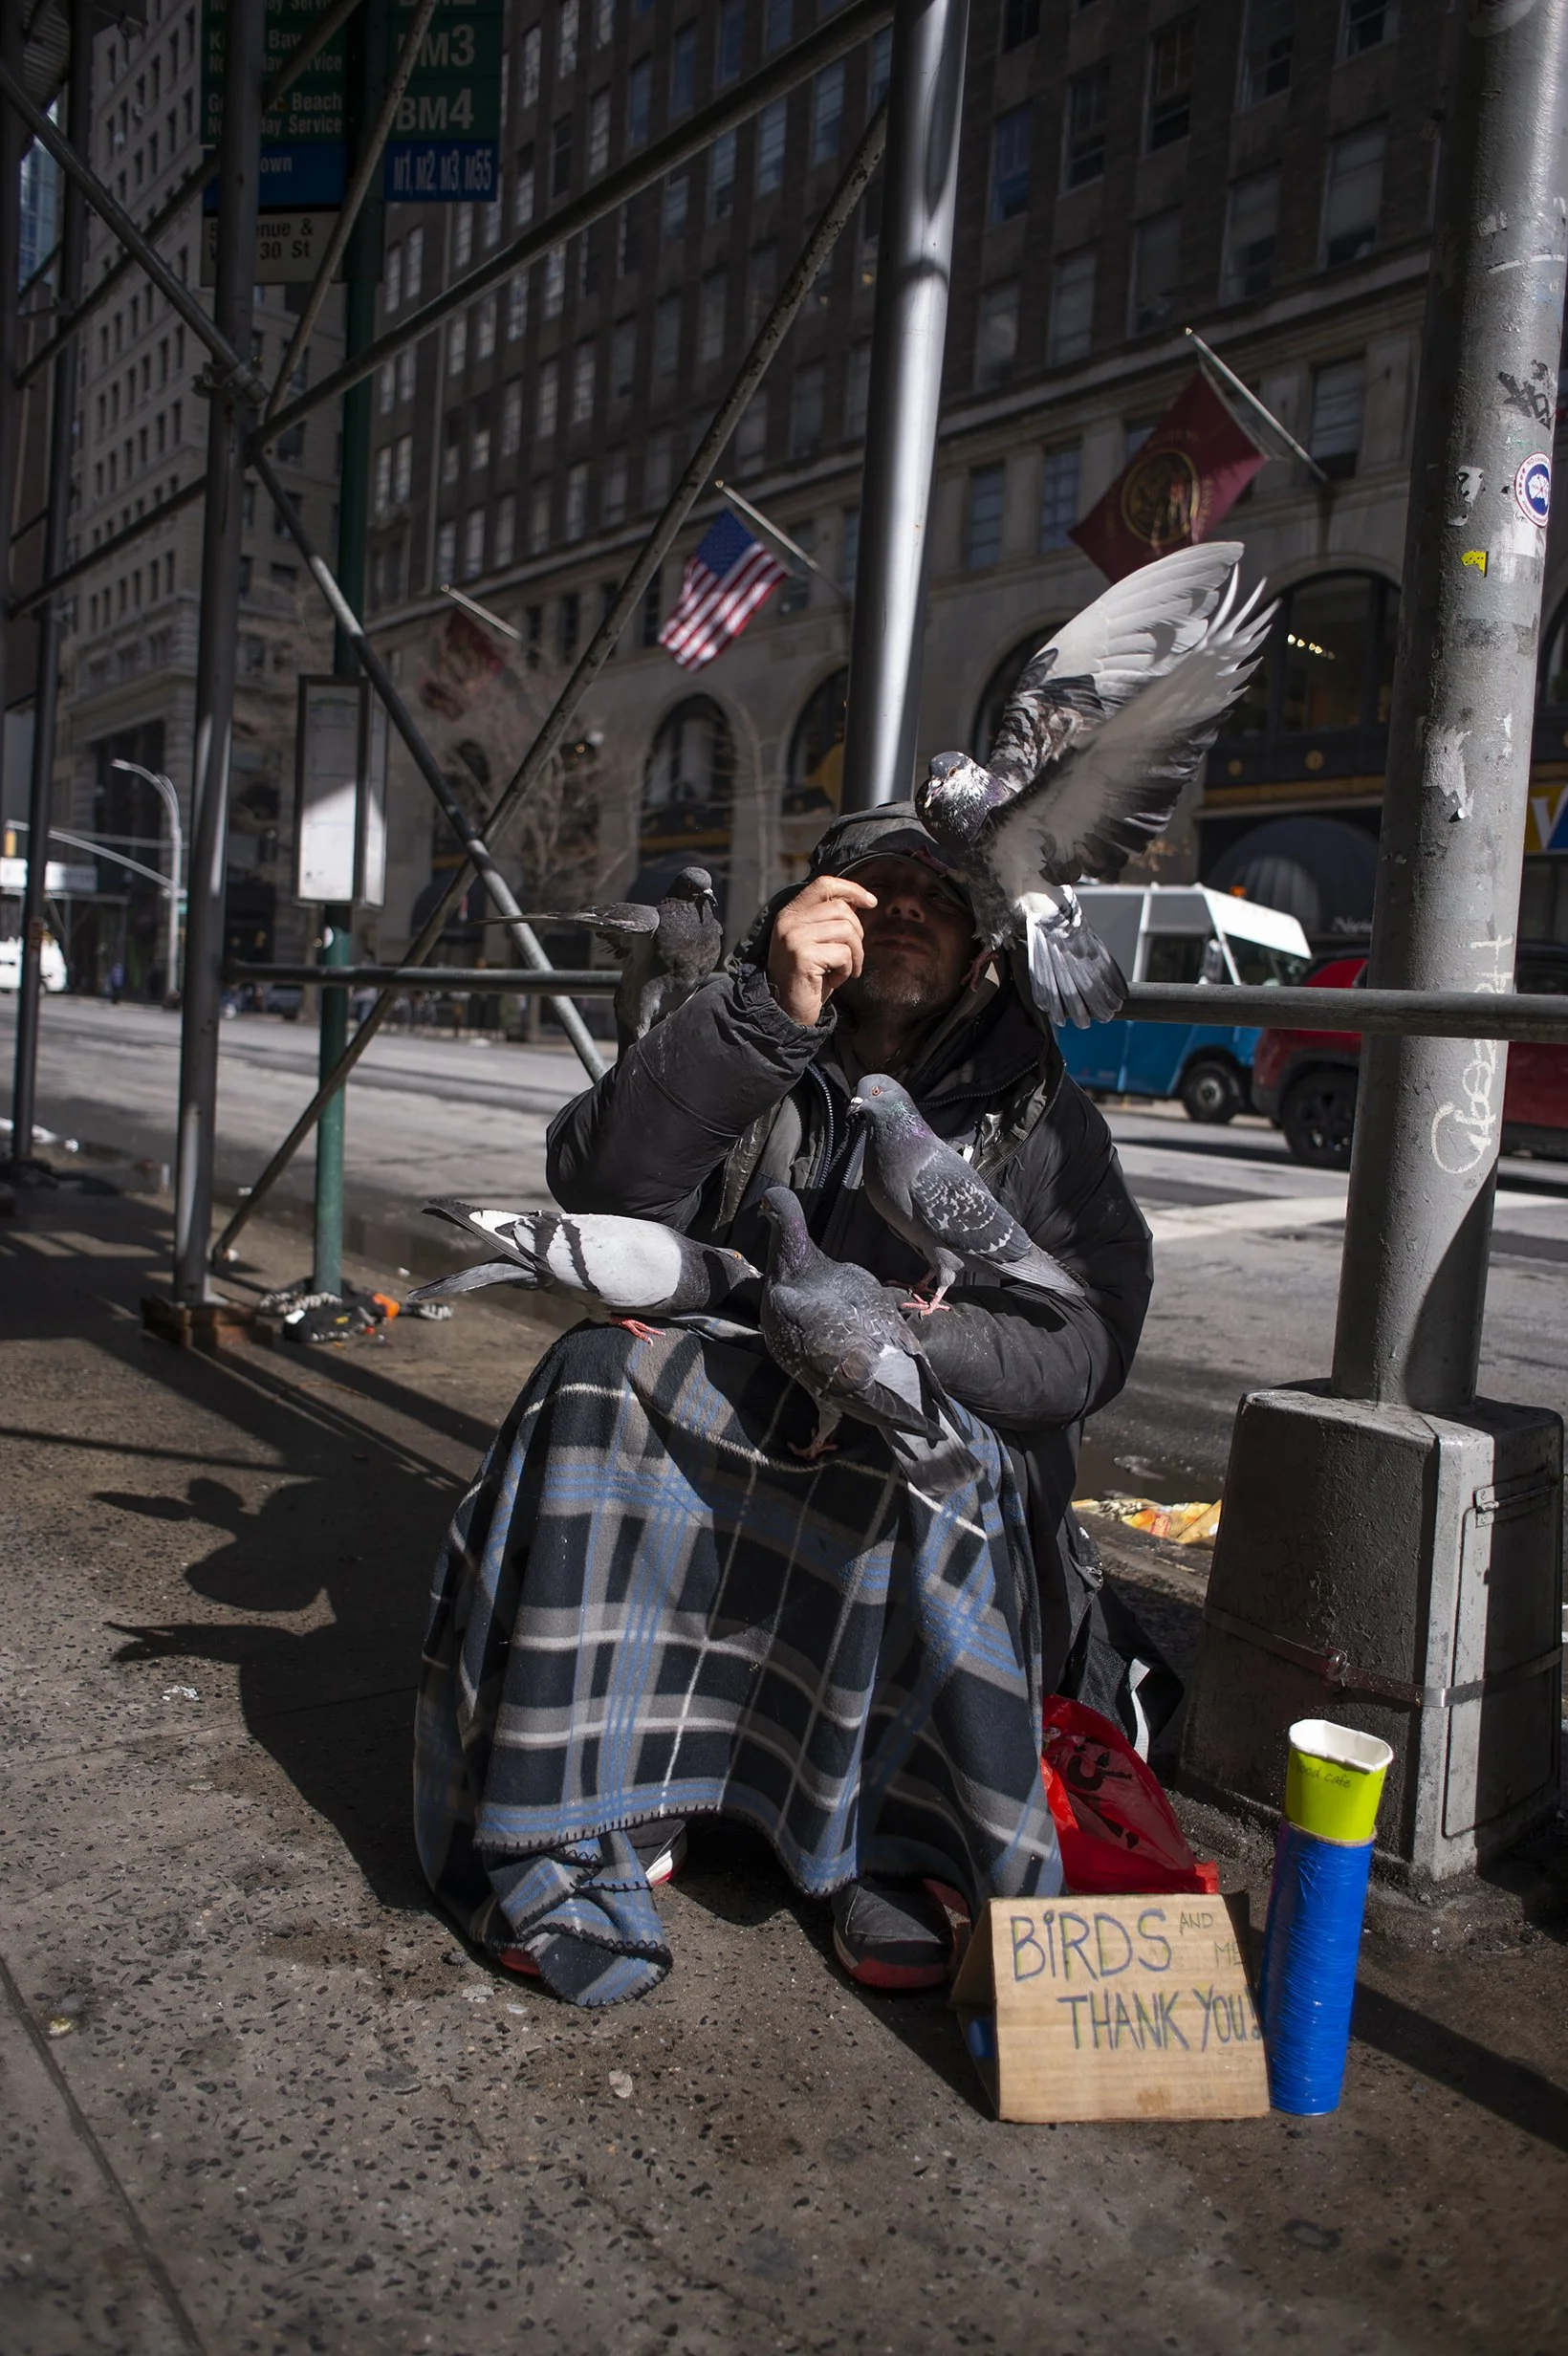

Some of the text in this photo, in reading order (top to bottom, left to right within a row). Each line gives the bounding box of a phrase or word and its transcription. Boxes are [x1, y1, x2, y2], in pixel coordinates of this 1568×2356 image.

[292, 93, 342, 112] Beach
[395, 88, 474, 132] BM4
[288, 114, 342, 136] Service
[464, 148, 492, 192] M55
[300, 218, 314, 236] &
[259, 240, 311, 261] 30 St
[1179, 1911, 1213, 1935] AND
[1056, 1983, 1263, 2053] THANK YOU!
